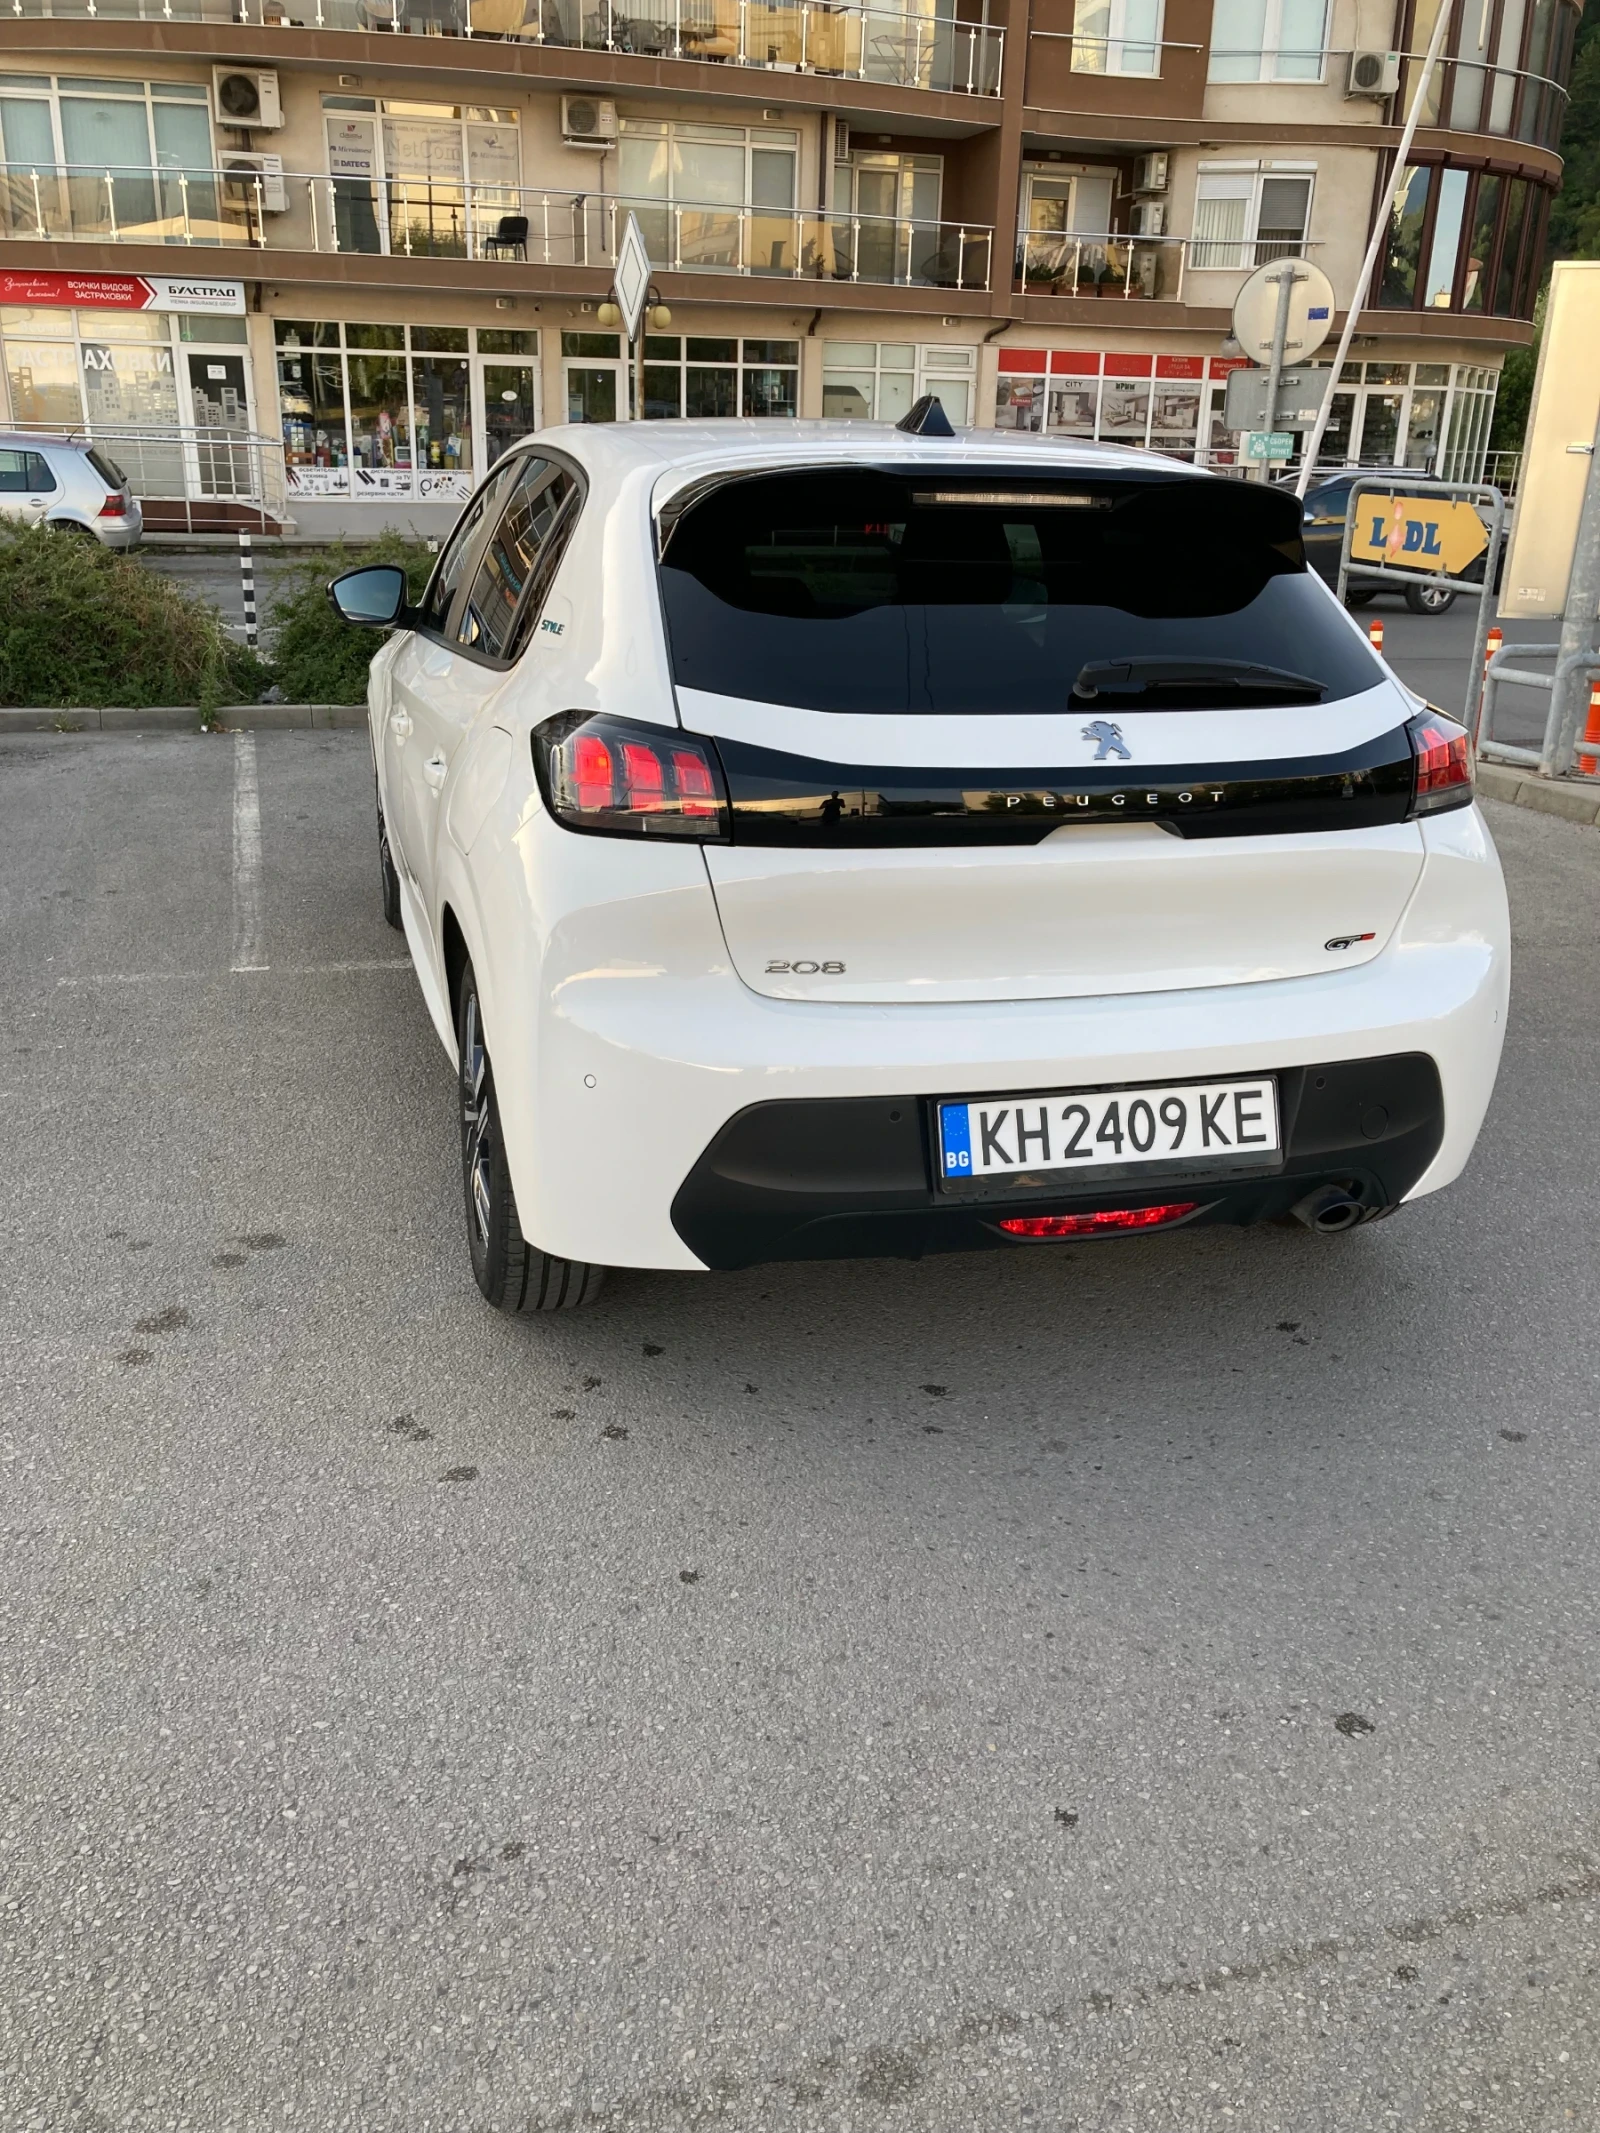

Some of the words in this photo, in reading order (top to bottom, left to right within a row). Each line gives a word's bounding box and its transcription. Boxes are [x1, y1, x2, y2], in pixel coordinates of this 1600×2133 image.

[385, 136, 461, 161] NetCom
[340, 160, 371, 169] DATECS
[67, 281, 100, 290] ВСИЧКИ
[101, 283, 134, 292] ВИДОВЕ
[168, 285, 236, 297] БУЛСТРАД
[74, 290, 132, 301] ЗАСТРАХОВКИ
[1065, 381, 1083, 389] CITY
[1270, 437, 1293, 445] СБОРЕН
[1270, 447, 1290, 455] ПУНКТ
[1369, 501, 1442, 558] LIDL
[541, 619, 565, 636] STYLE
[1006, 791, 1224, 808] PEUGEOT
[764, 959, 847, 975] 208
[946, 1150, 969, 1169] BG
